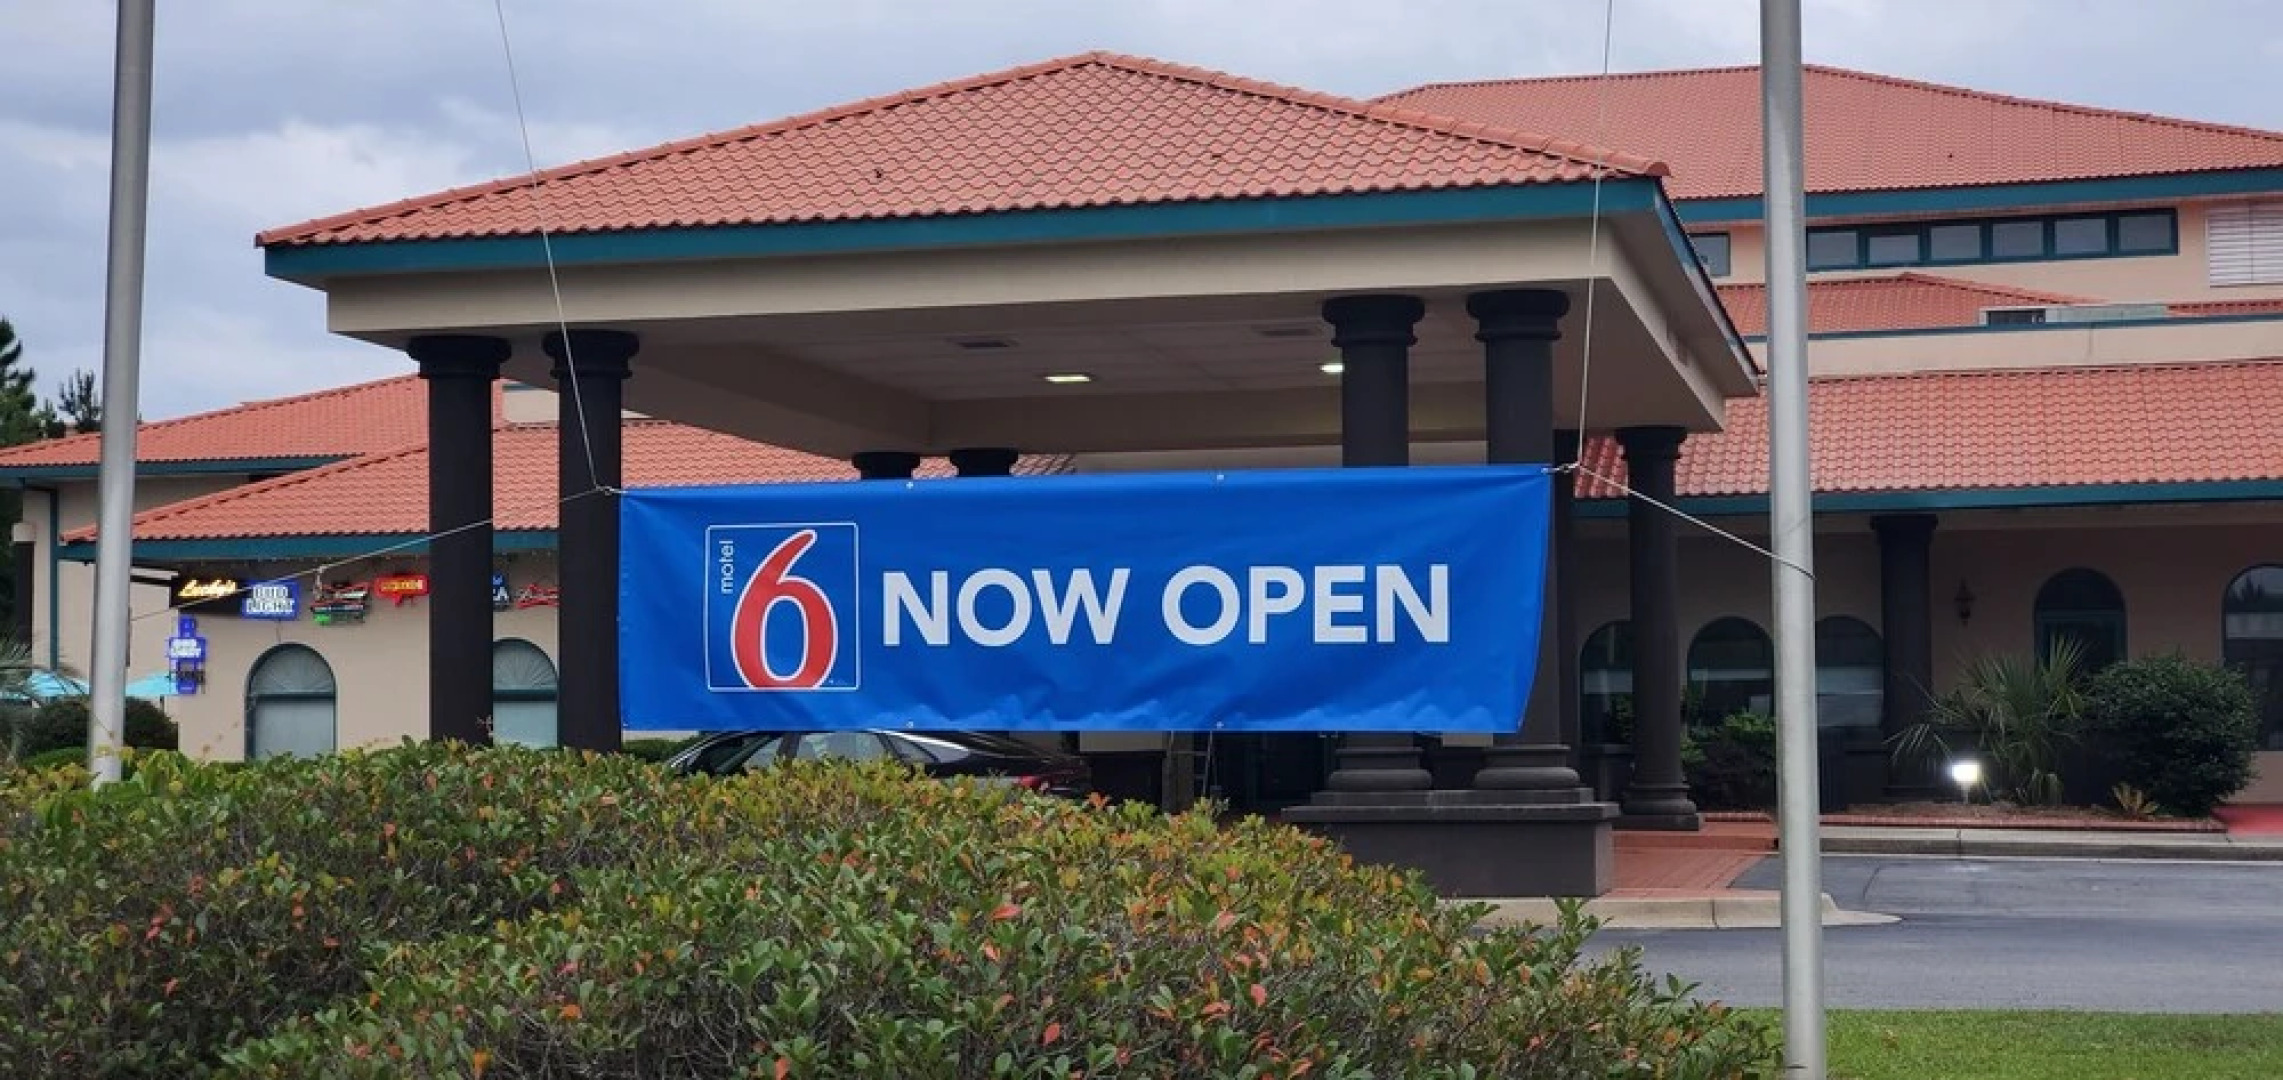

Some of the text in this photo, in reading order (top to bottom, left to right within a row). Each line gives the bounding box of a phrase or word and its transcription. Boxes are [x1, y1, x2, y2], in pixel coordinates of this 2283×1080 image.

[718, 540, 734, 595] motel
[883, 564, 1450, 646] NOW OPEN
[730, 529, 839, 690] 6
